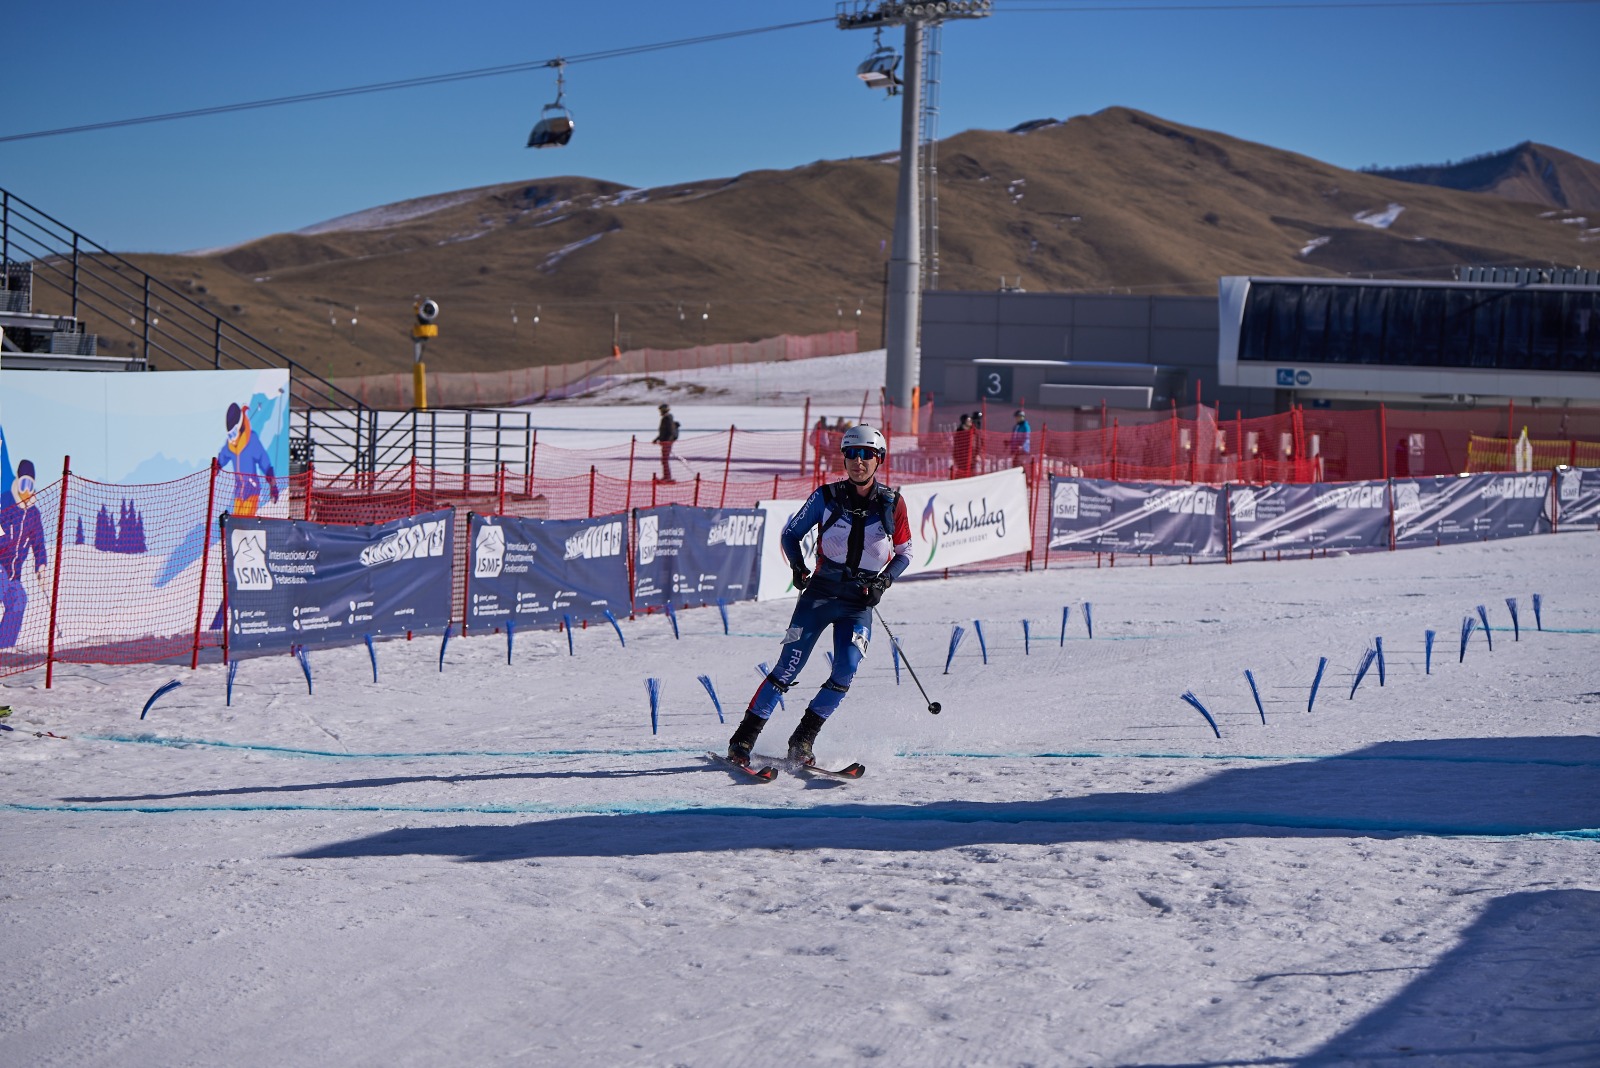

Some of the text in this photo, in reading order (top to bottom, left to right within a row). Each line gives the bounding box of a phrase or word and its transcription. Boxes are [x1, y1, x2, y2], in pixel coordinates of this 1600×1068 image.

[986, 373, 1002, 395] 3
[1055, 503, 1077, 515] ISMF
[943, 497, 1006, 538] Shahdag
[269, 562, 316, 575] Mountaineering
[477, 557, 500, 573] ISMF
[236, 567, 268, 584] ISMF
